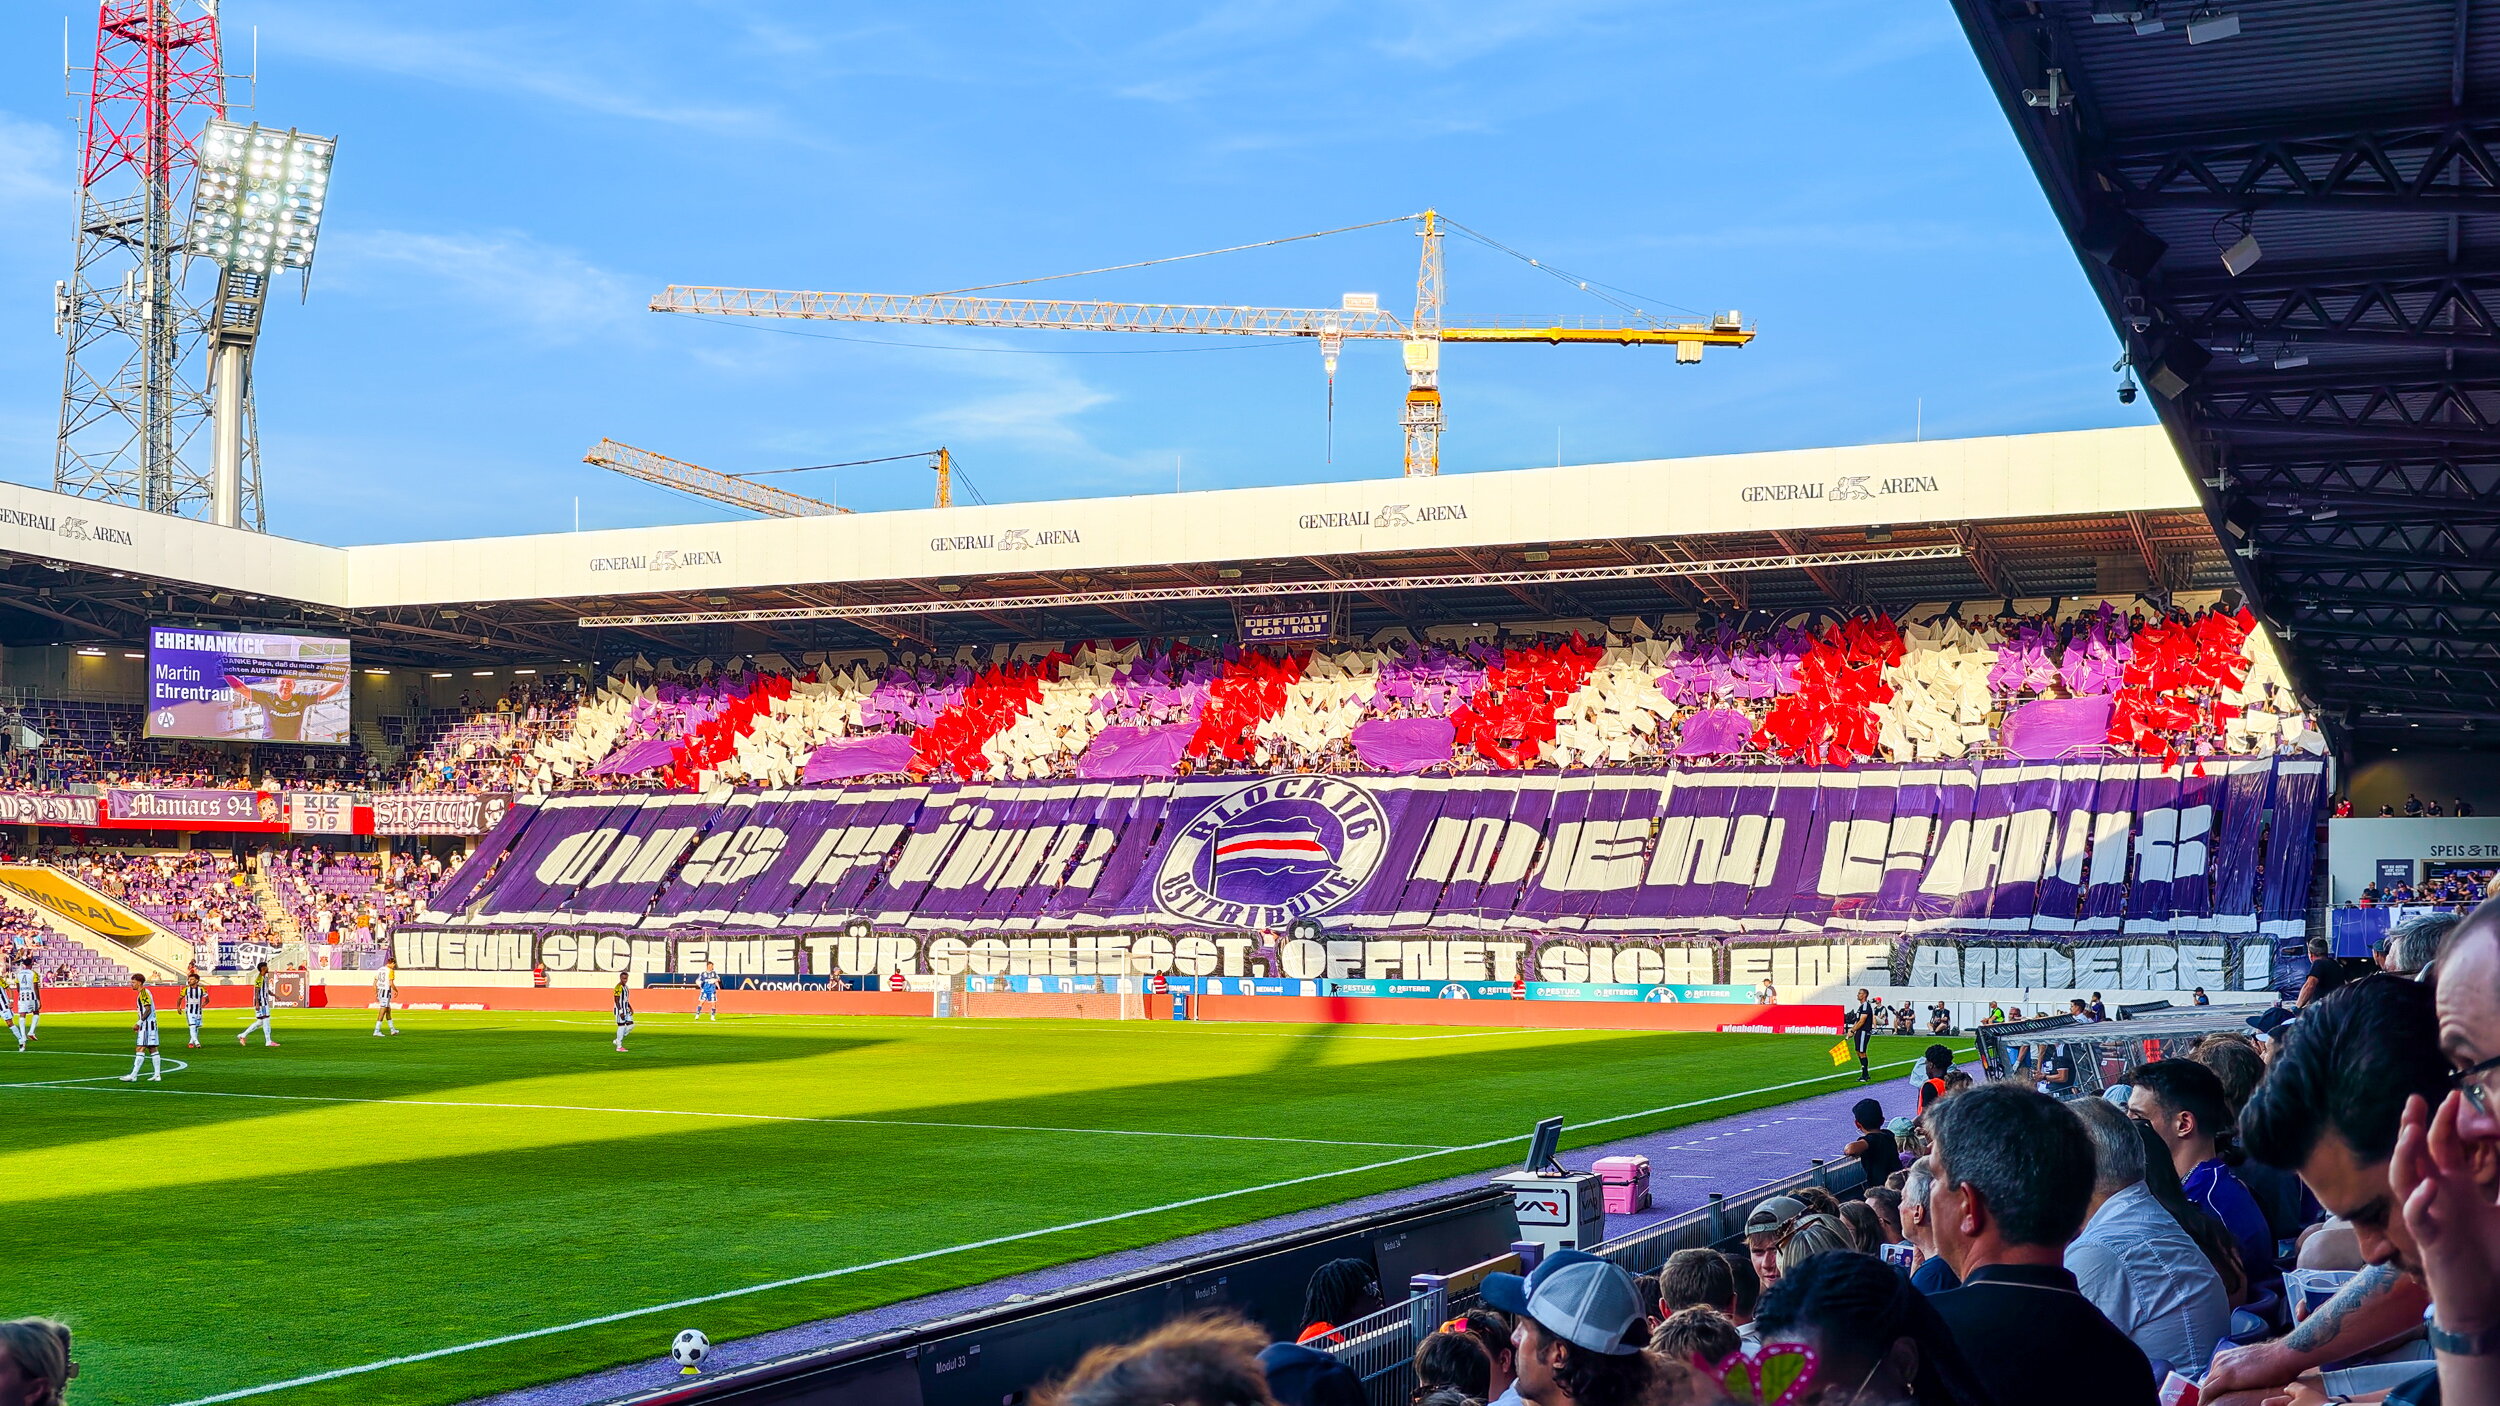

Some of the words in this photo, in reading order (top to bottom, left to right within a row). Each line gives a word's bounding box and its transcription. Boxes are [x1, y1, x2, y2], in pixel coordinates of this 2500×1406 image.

[1741, 483, 1824, 502] GENERALI
[1879, 476, 1939, 494] ARENA
[0, 508, 55, 531] GENERALI
[93, 526, 132, 545] ARENA
[1299, 511, 1370, 529] GENERALI
[1416, 505, 1468, 521] ARENA
[931, 535, 994, 551] GENERALI
[1035, 529, 1080, 545] ARENA
[590, 556, 646, 571] GENERALI
[681, 551, 722, 566] ARENA
[1245, 614, 1327, 628] DIFFIDATI
[1251, 626, 1286, 636] CON
[1292, 624, 1322, 634] NOI
[155, 632, 265, 655] EHRENANKICK
[156, 664, 201, 682] Martin
[250, 667, 298, 676] AUSTRIANER
[156, 683, 235, 702] Ehrentraut
[129, 793, 221, 817] Maniacs
[227, 796, 253, 816] 94
[1185, 778, 1336, 841] BLOCK
[1330, 790, 1379, 841] 116
[1406, 814, 1787, 891] DEN
[2430, 845, 2465, 856] SPEIS
[2467, 845, 2482, 856] &
[0, 878, 132, 930] DMIRAL
[394, 932, 533, 970] WENN
[542, 934, 667, 973] SICH
[677, 937, 799, 975] EINE
[805, 925, 921, 975] TÜR
[1281, 926, 1526, 981] ÖFFNET
[1540, 946, 1715, 984] SICH
[1730, 944, 1892, 986] EINE
[1195, 1286, 1211, 1299] Modul
[936, 1357, 957, 1374] Modul
[958, 1355, 966, 1368] 33
